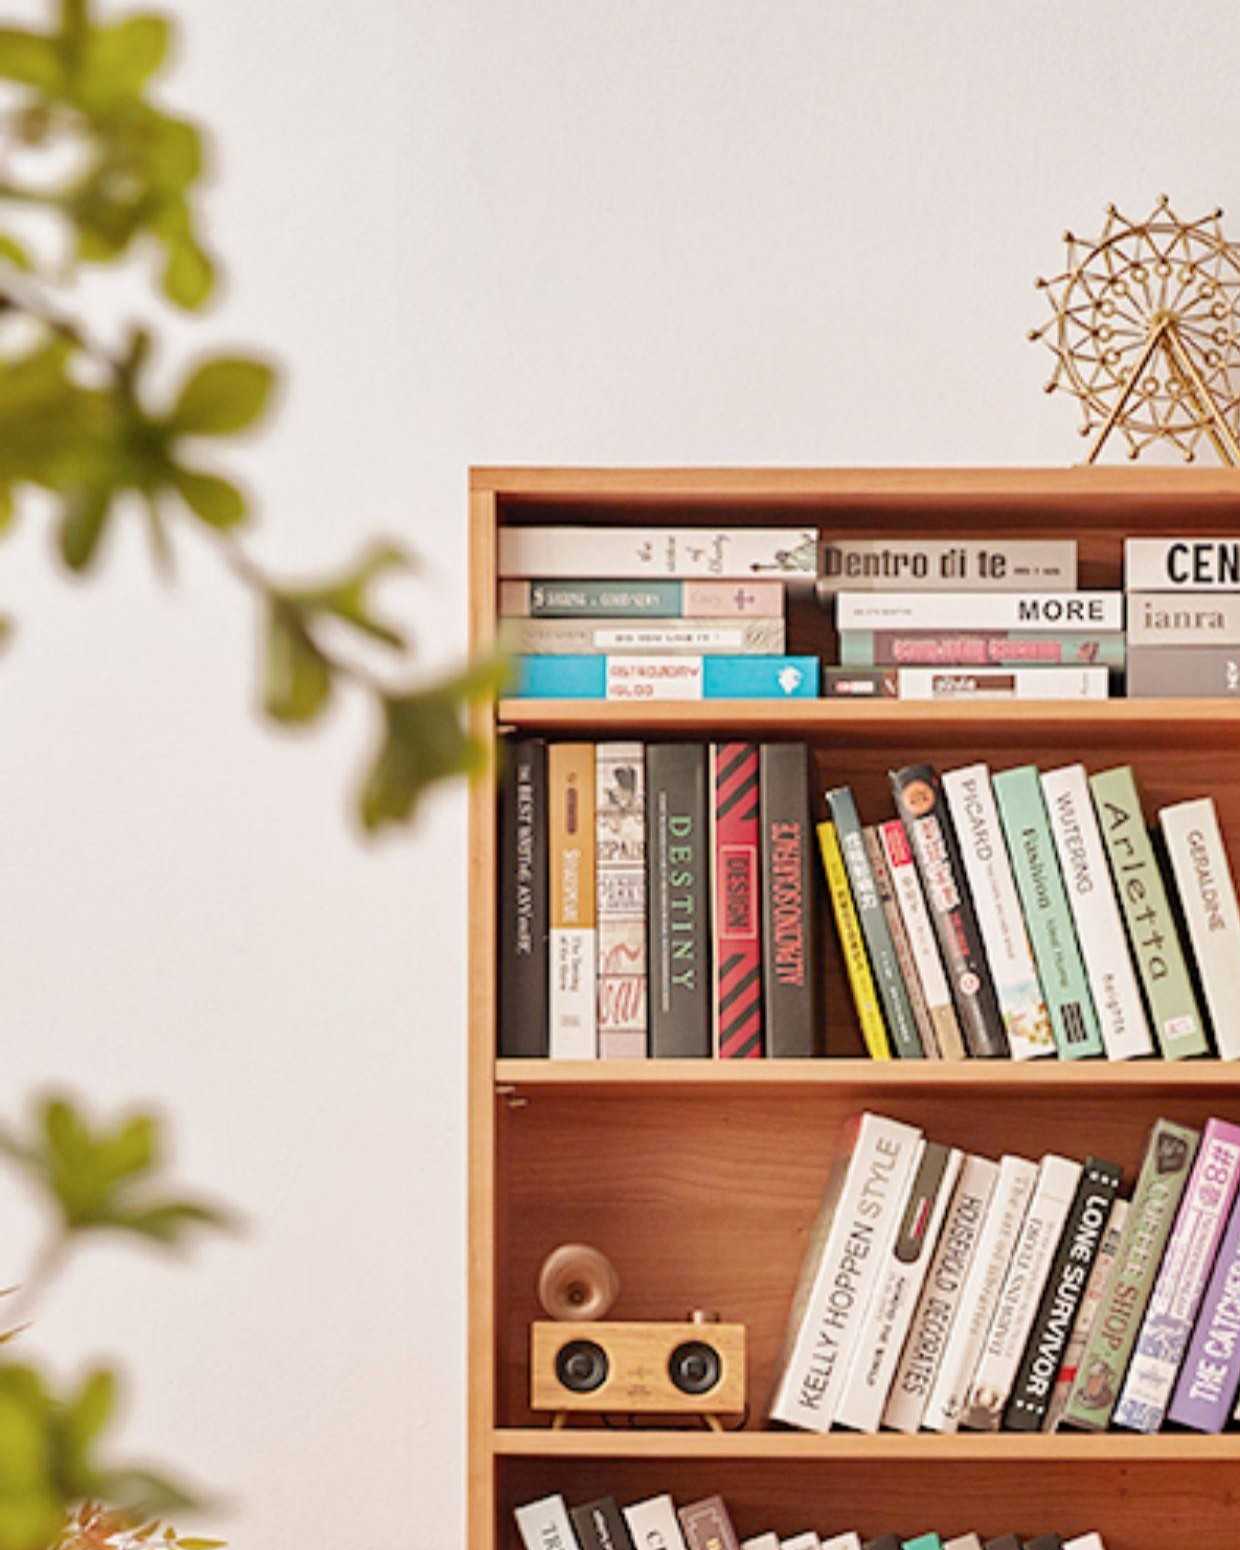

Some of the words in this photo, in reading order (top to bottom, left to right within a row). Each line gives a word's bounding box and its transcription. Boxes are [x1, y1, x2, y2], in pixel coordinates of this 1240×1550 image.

[825, 547, 928, 579] Dentro
[939, 545, 967, 579] di
[977, 549, 1007, 579] te
[1018, 599, 1105, 622] MORE
[961, 779, 994, 861] PICARD
[667, 816, 695, 992] DESTINY
[726, 856, 749, 928] DESIGN
[1021, 827, 1049, 909] Fashion
[1103, 802, 1170, 981] Arletta
[1187, 830, 1226, 933] GERALDINE
[934, 1193, 983, 1293] HOUSEHOLD
[1069, 1195, 1107, 1261] LONE
[1126, 1181, 1169, 1277] COFFEE
[799, 1332, 838, 1411] KELLY
[823, 1220, 874, 1330] HOPPEN
[855, 1135, 900, 1220] STYLE
[1025, 1264, 1084, 1399] SURVIVOR
[1101, 1280, 1140, 1351] SHOP
[1188, 1357, 1229, 1401] THE
